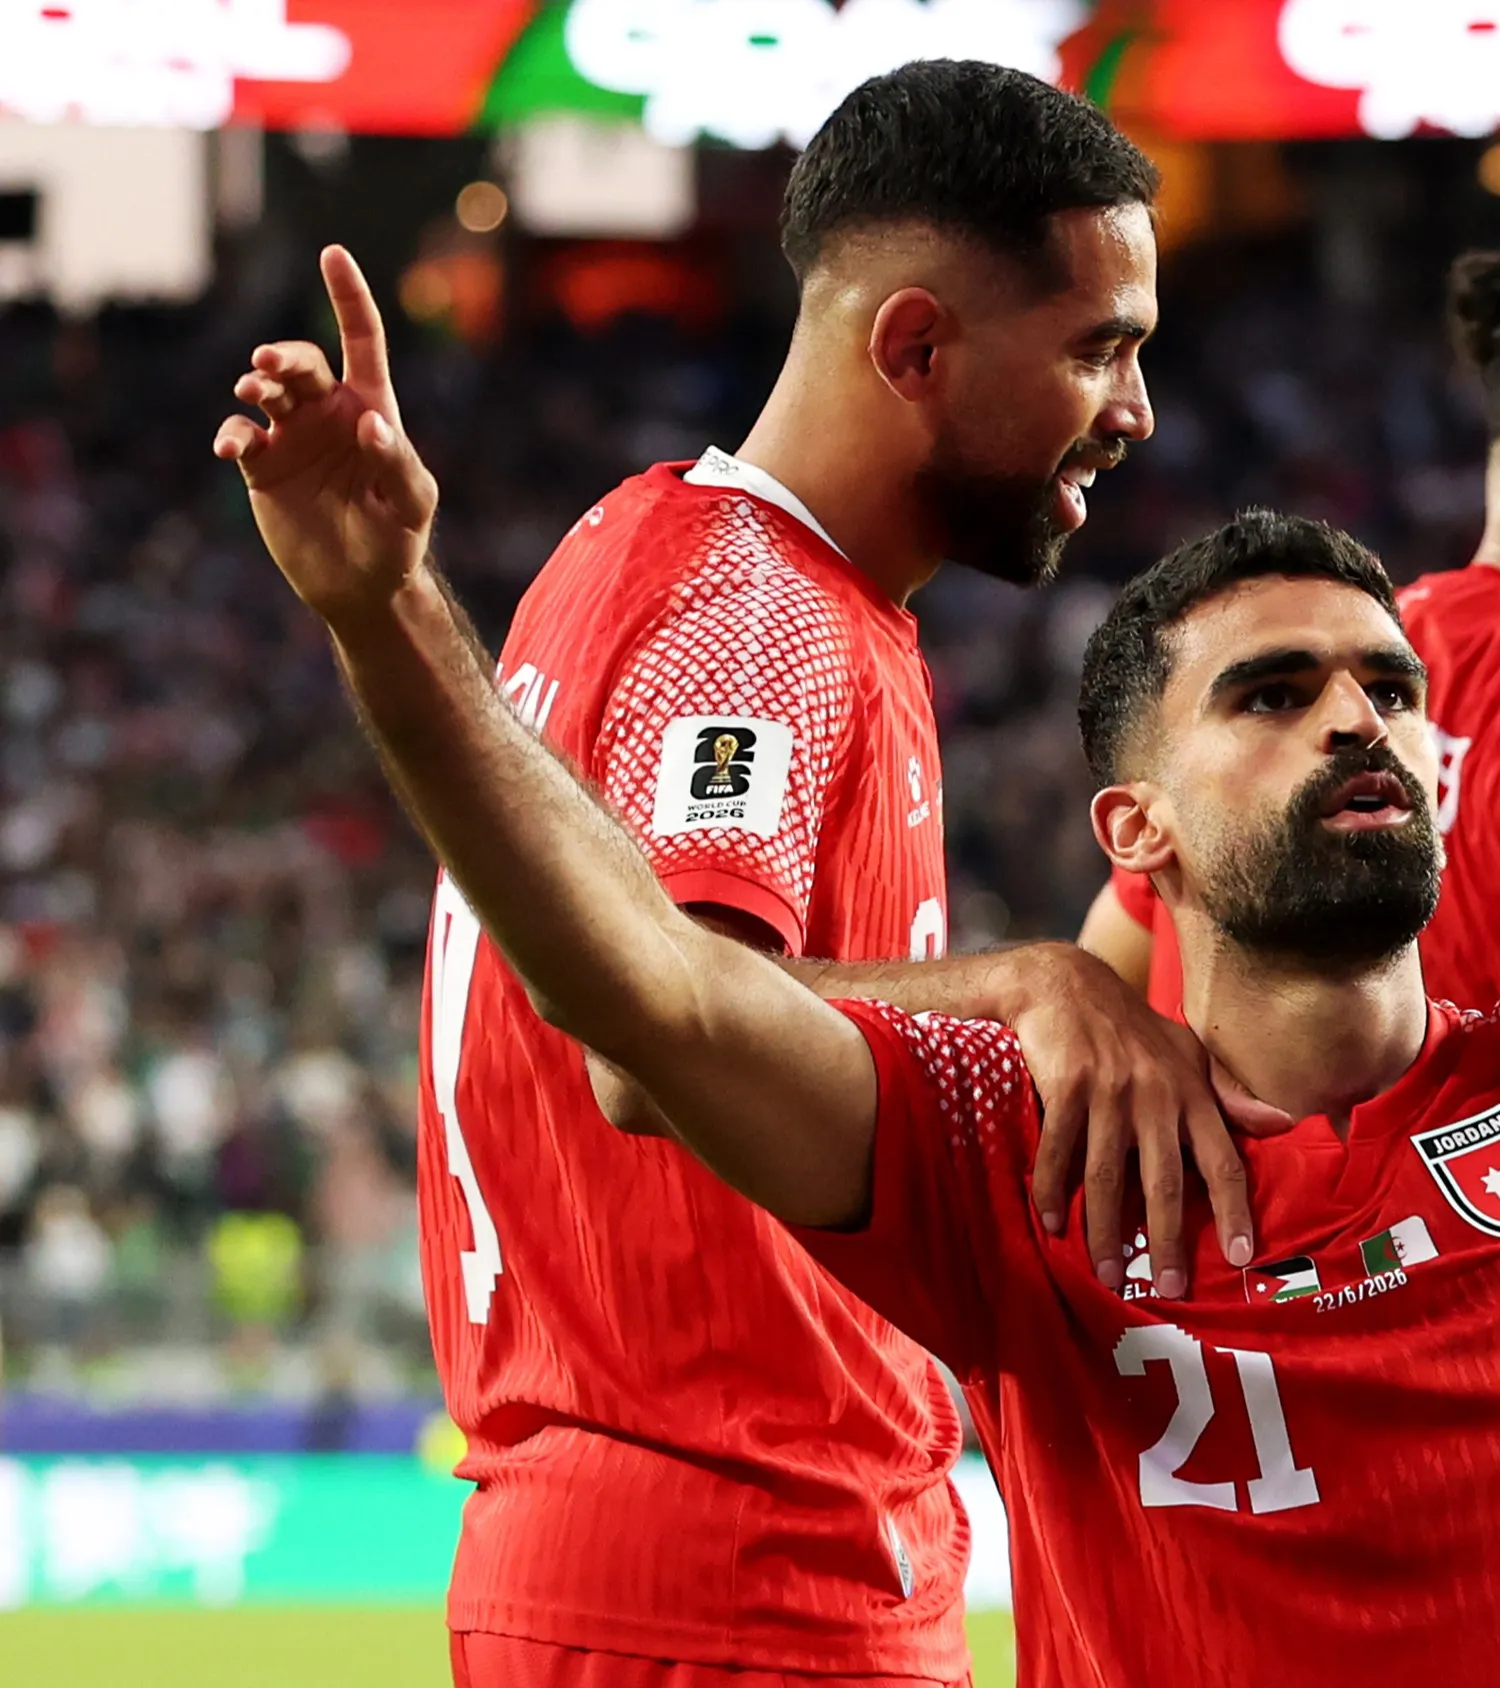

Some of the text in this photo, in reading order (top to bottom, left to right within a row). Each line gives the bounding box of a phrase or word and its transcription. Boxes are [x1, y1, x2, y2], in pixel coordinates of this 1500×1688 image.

[706, 784, 734, 795] FIFA
[687, 800, 747, 811] WORLD CUP
[685, 807, 745, 823] 2026
[1312, 1267, 1408, 1314] 22/6/2026
[1112, 1322, 1321, 1515] 21
